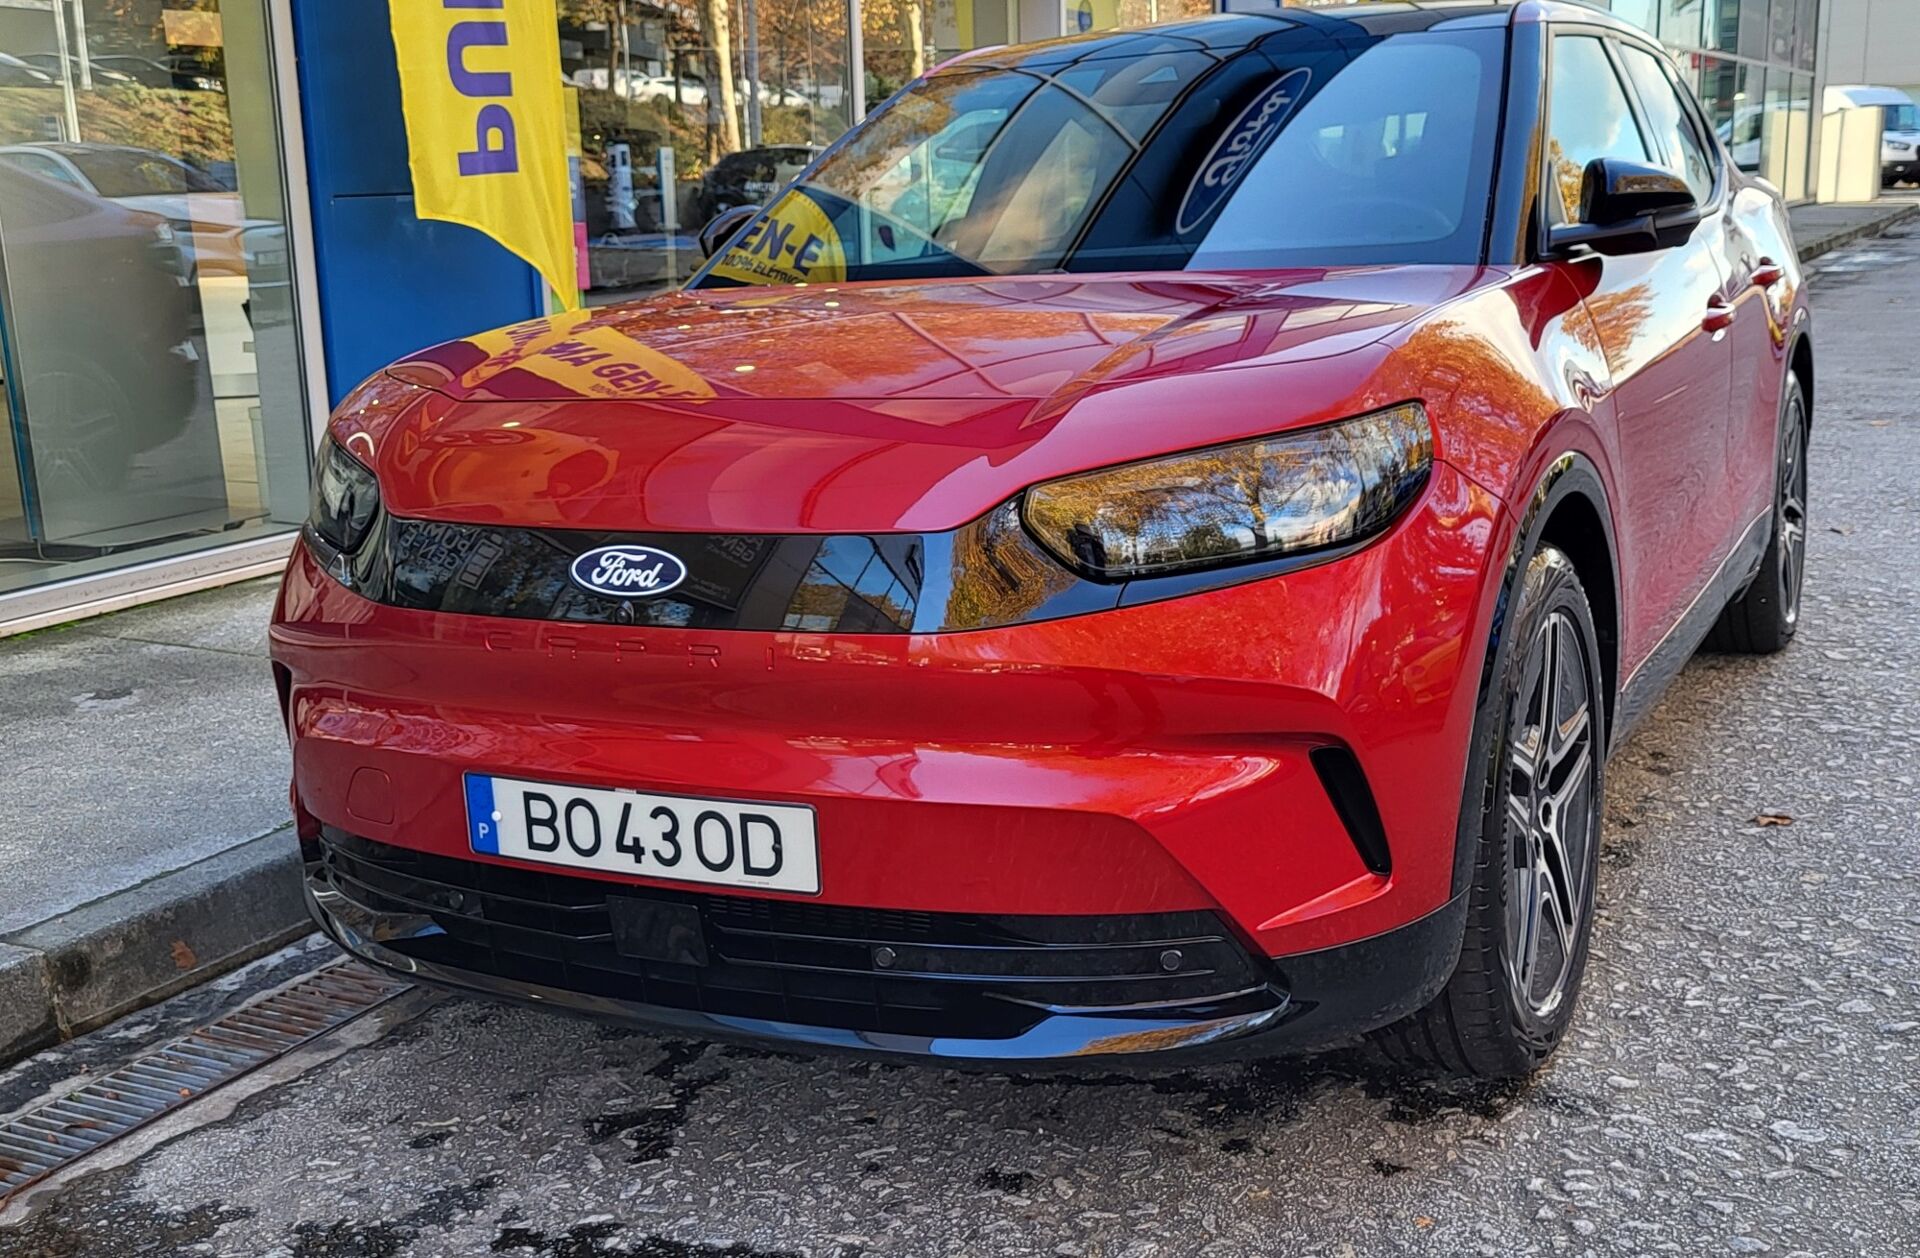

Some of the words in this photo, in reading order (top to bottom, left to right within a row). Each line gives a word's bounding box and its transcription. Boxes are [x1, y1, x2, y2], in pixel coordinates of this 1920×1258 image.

[591, 551, 664, 588] Ford
[485, 631, 775, 671] CAPRI
[478, 822, 490, 840] P
[522, 791, 601, 858] BO
[615, 802, 682, 868] 43
[694, 810, 783, 877] OD
